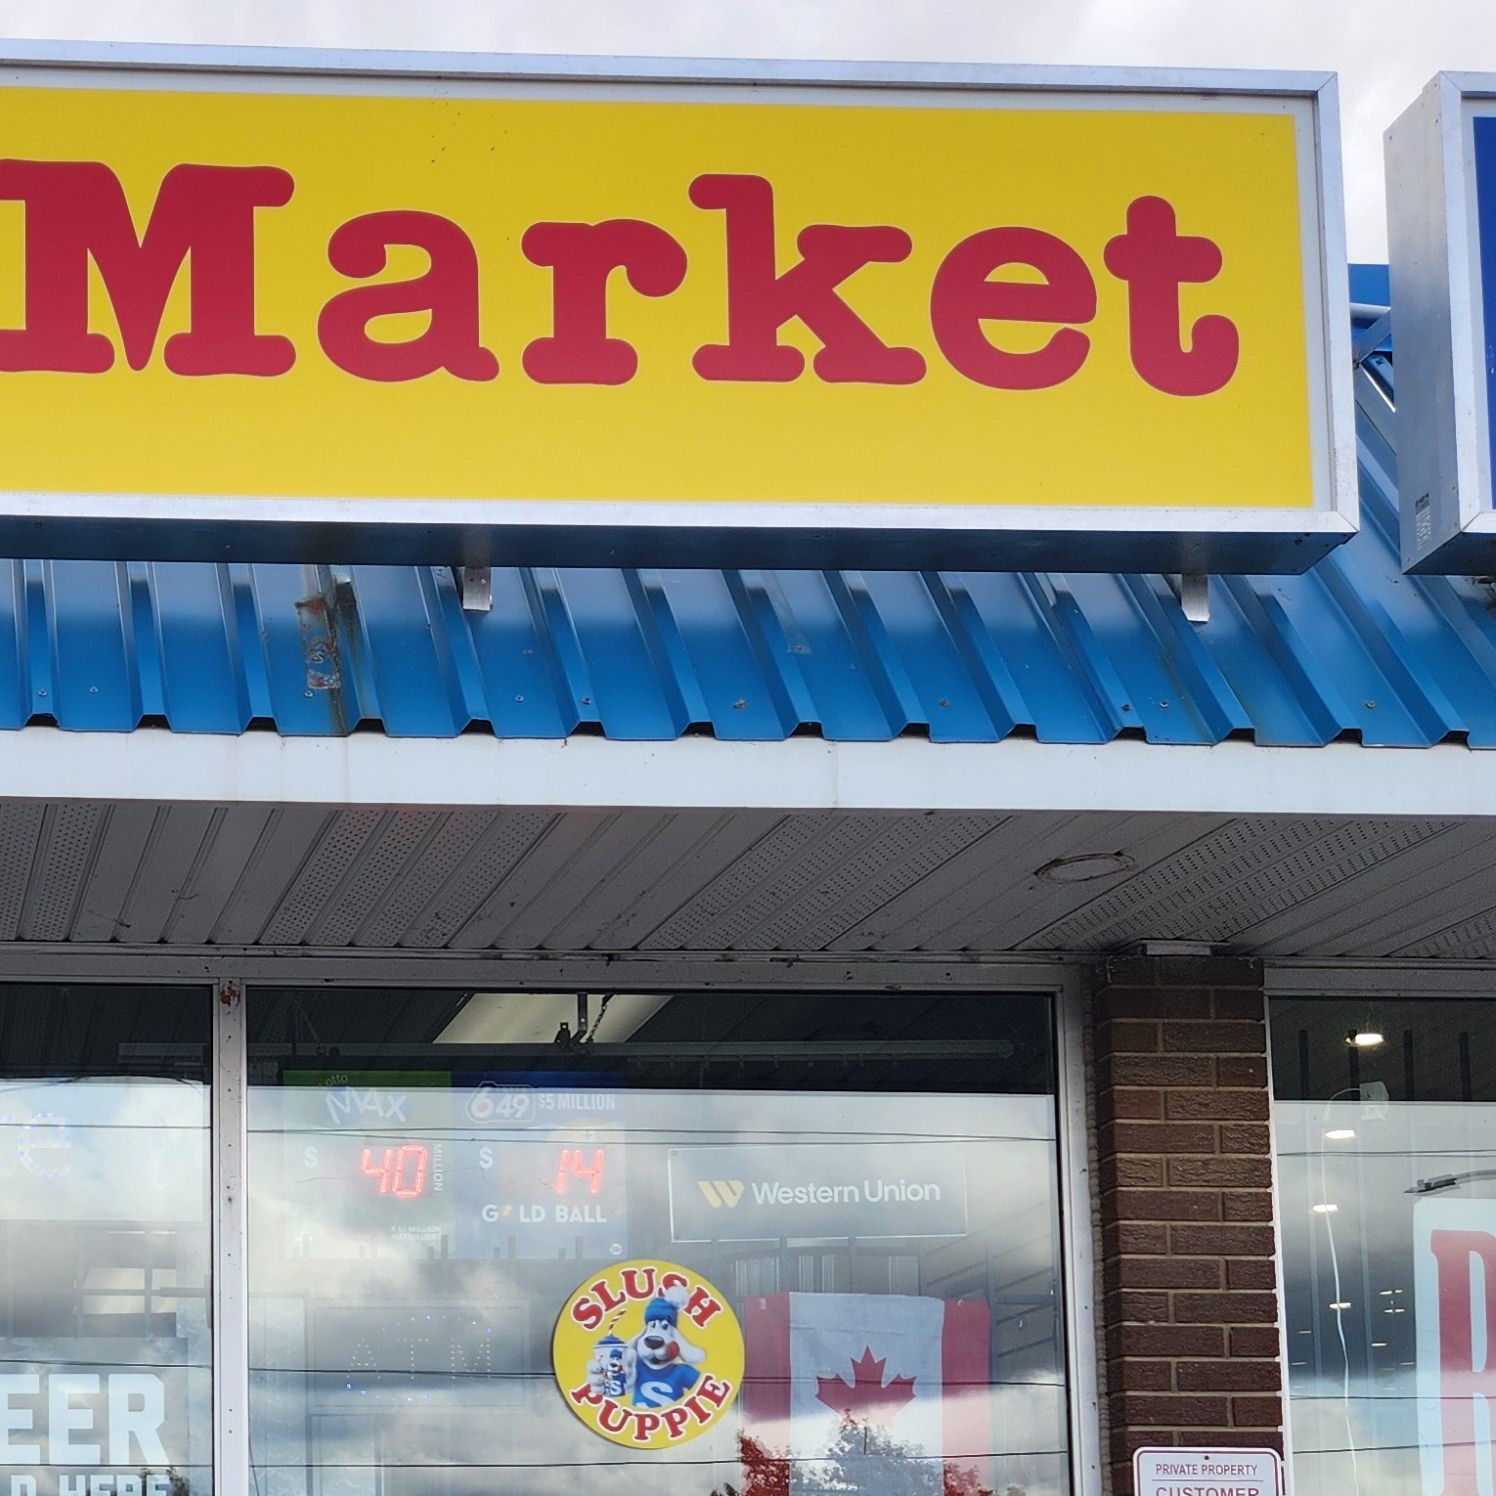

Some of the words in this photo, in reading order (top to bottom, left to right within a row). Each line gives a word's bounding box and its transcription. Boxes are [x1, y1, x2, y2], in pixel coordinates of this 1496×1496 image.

[325, 1086, 407, 1124] MAX
[471, 1085, 530, 1119] 649
[558, 1093, 616, 1110] MILLION
[361, 1145, 429, 1198] 40
[434, 1143, 443, 1192] MILLION
[557, 1149, 605, 1195] 14
[752, 1181, 859, 1205] Western
[864, 1179, 941, 1202] Union
[481, 1204, 546, 1222] GLD
[555, 1204, 607, 1222] BALL
[571, 1375, 732, 1441] PUPPIE
[1156, 1464, 1198, 1475] PRIVATE
[1201, 1464, 1258, 1476] PROPERTY
